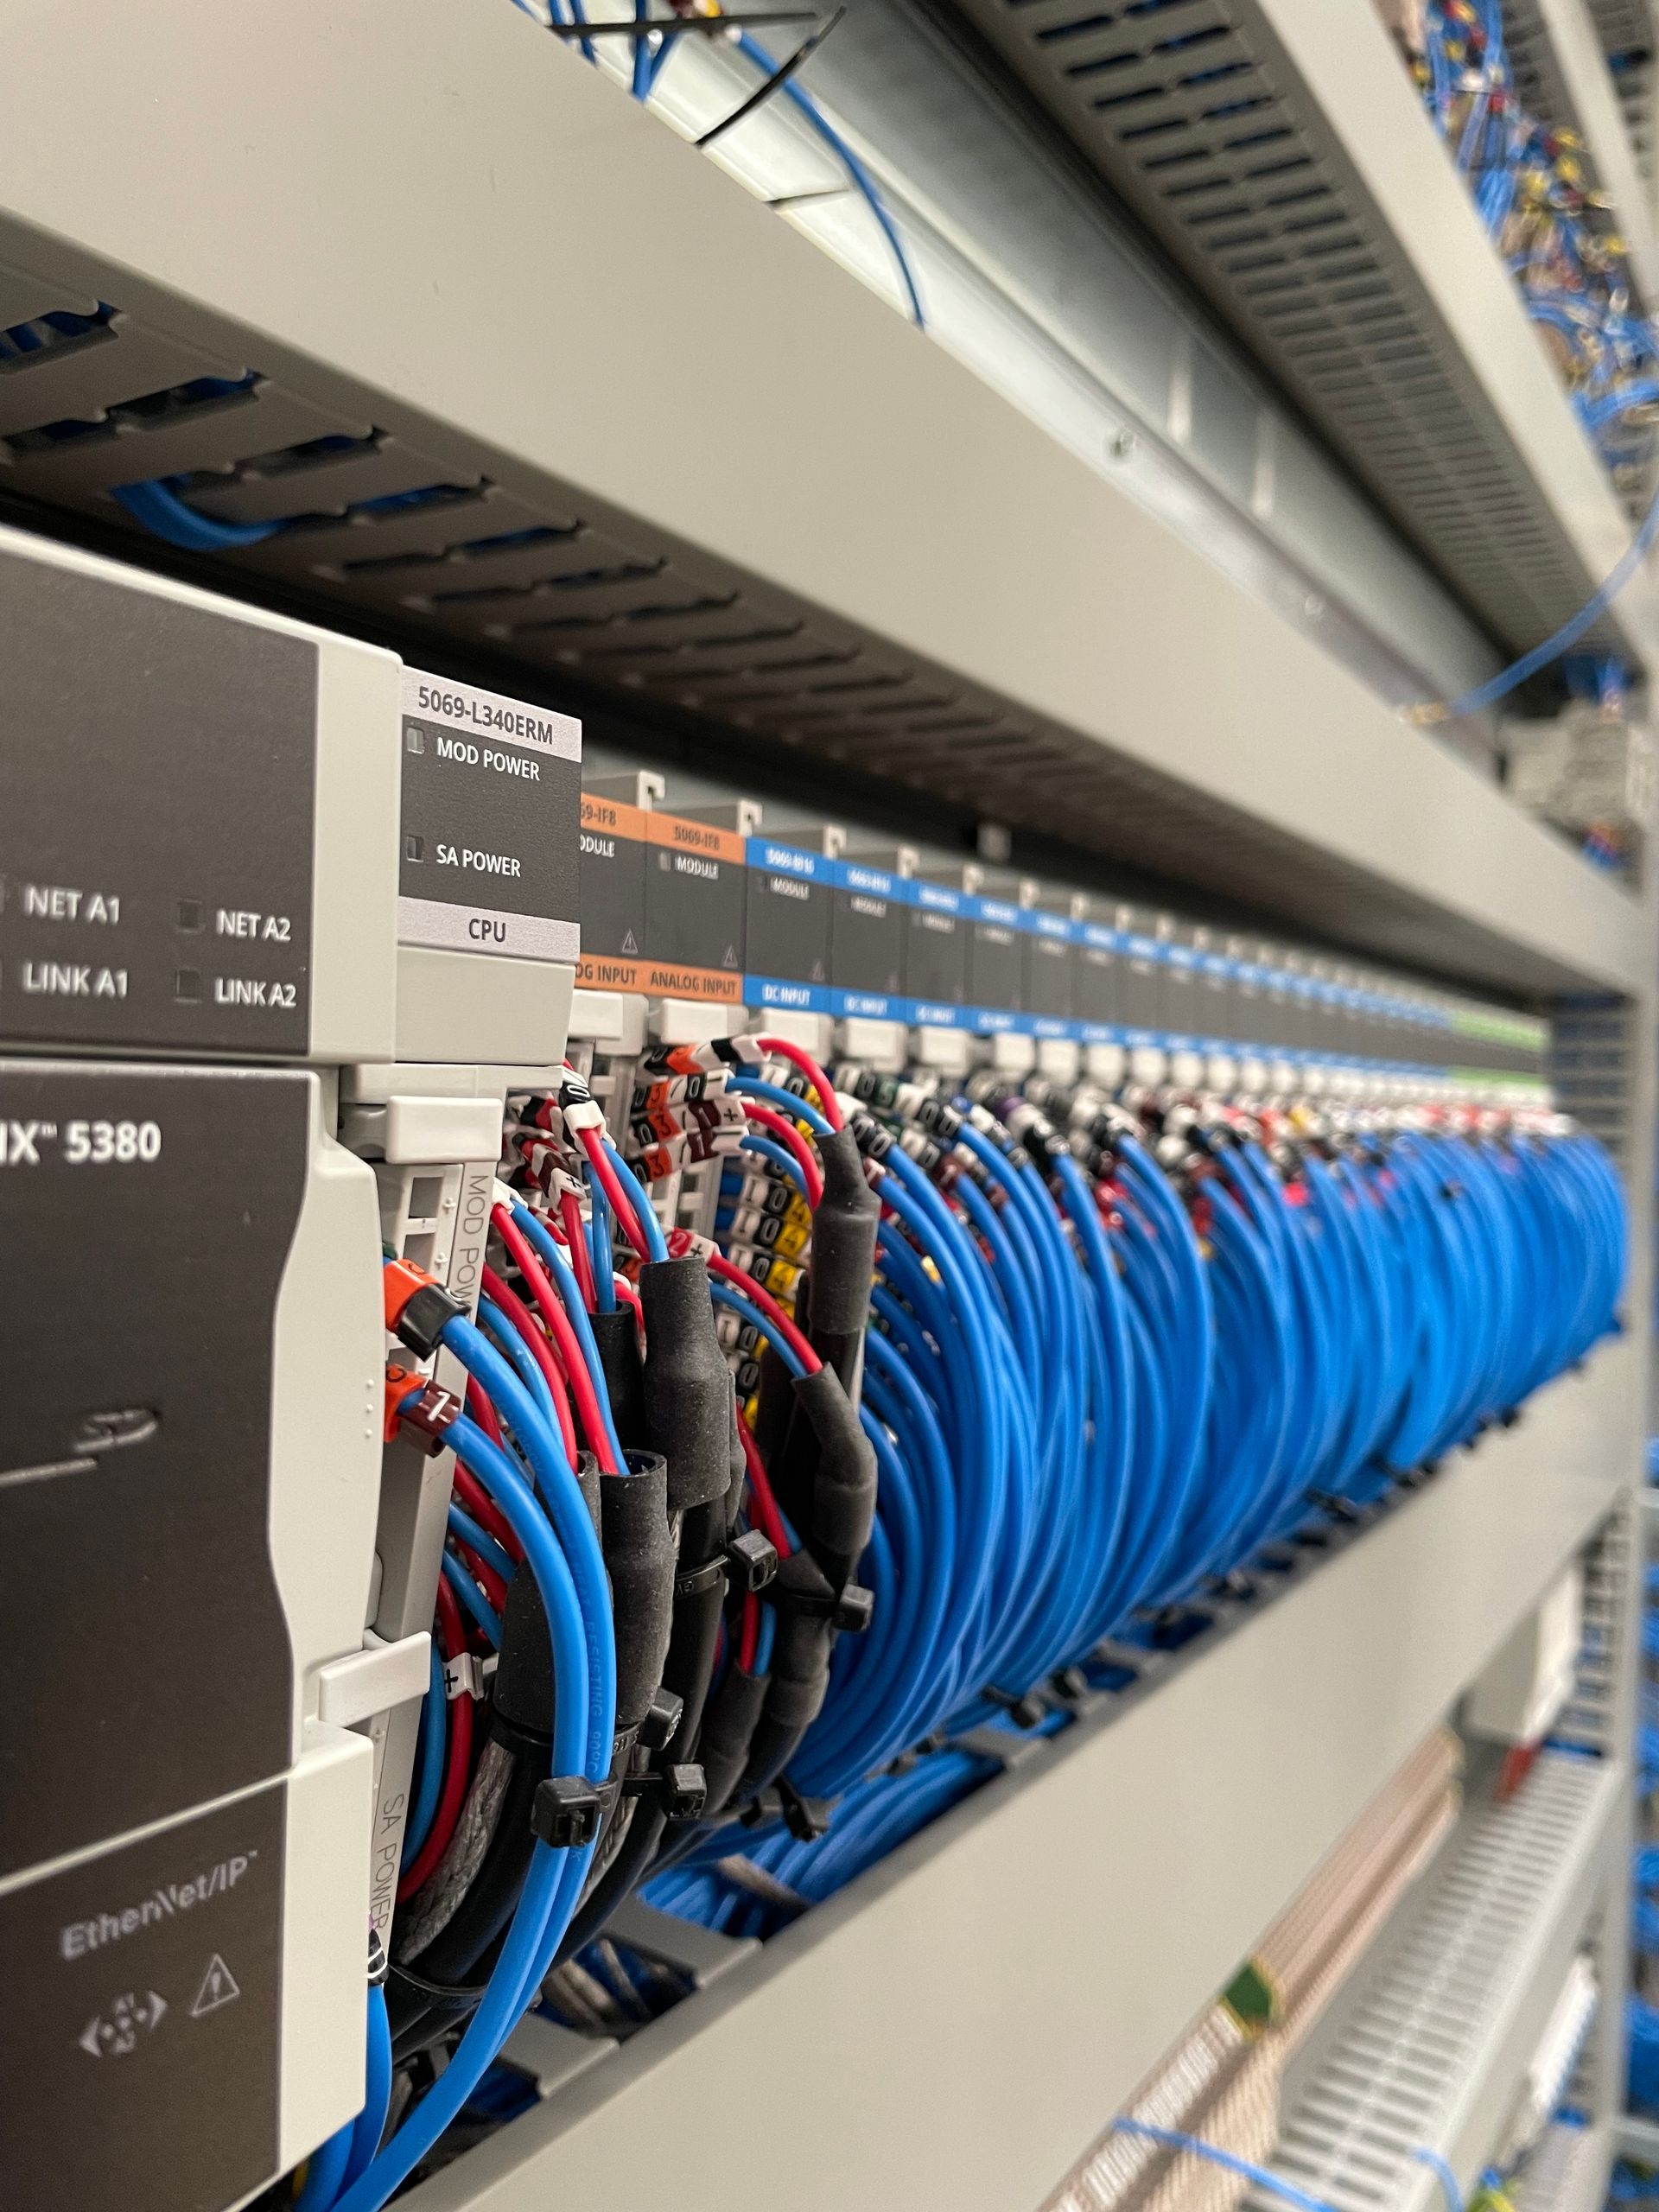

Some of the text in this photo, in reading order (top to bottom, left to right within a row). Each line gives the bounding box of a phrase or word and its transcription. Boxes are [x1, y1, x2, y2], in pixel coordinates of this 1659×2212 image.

[419, 685, 553, 745] 5069-L340ERM
[436, 737, 541, 781] MOD POWER
[674, 825, 721, 850] 5069-IF8
[436, 843, 521, 878] SA POWER
[675, 855, 720, 880] MODULE
[26, 883, 121, 925] NET A1
[216, 908, 292, 942] NET A2
[468, 918, 506, 943] CPU
[22, 960, 129, 999] LINK A1
[597, 964, 638, 985] INPUT
[650, 971, 737, 995] ANALOG INPUT
[215, 976, 297, 1008] LINK A2
[762, 983, 810, 1005] DC INPUT
[66, 1118, 162, 1165] 5380
[454, 1175, 489, 1303] MOD POW
[371, 1793, 405, 1929] SA POWER
